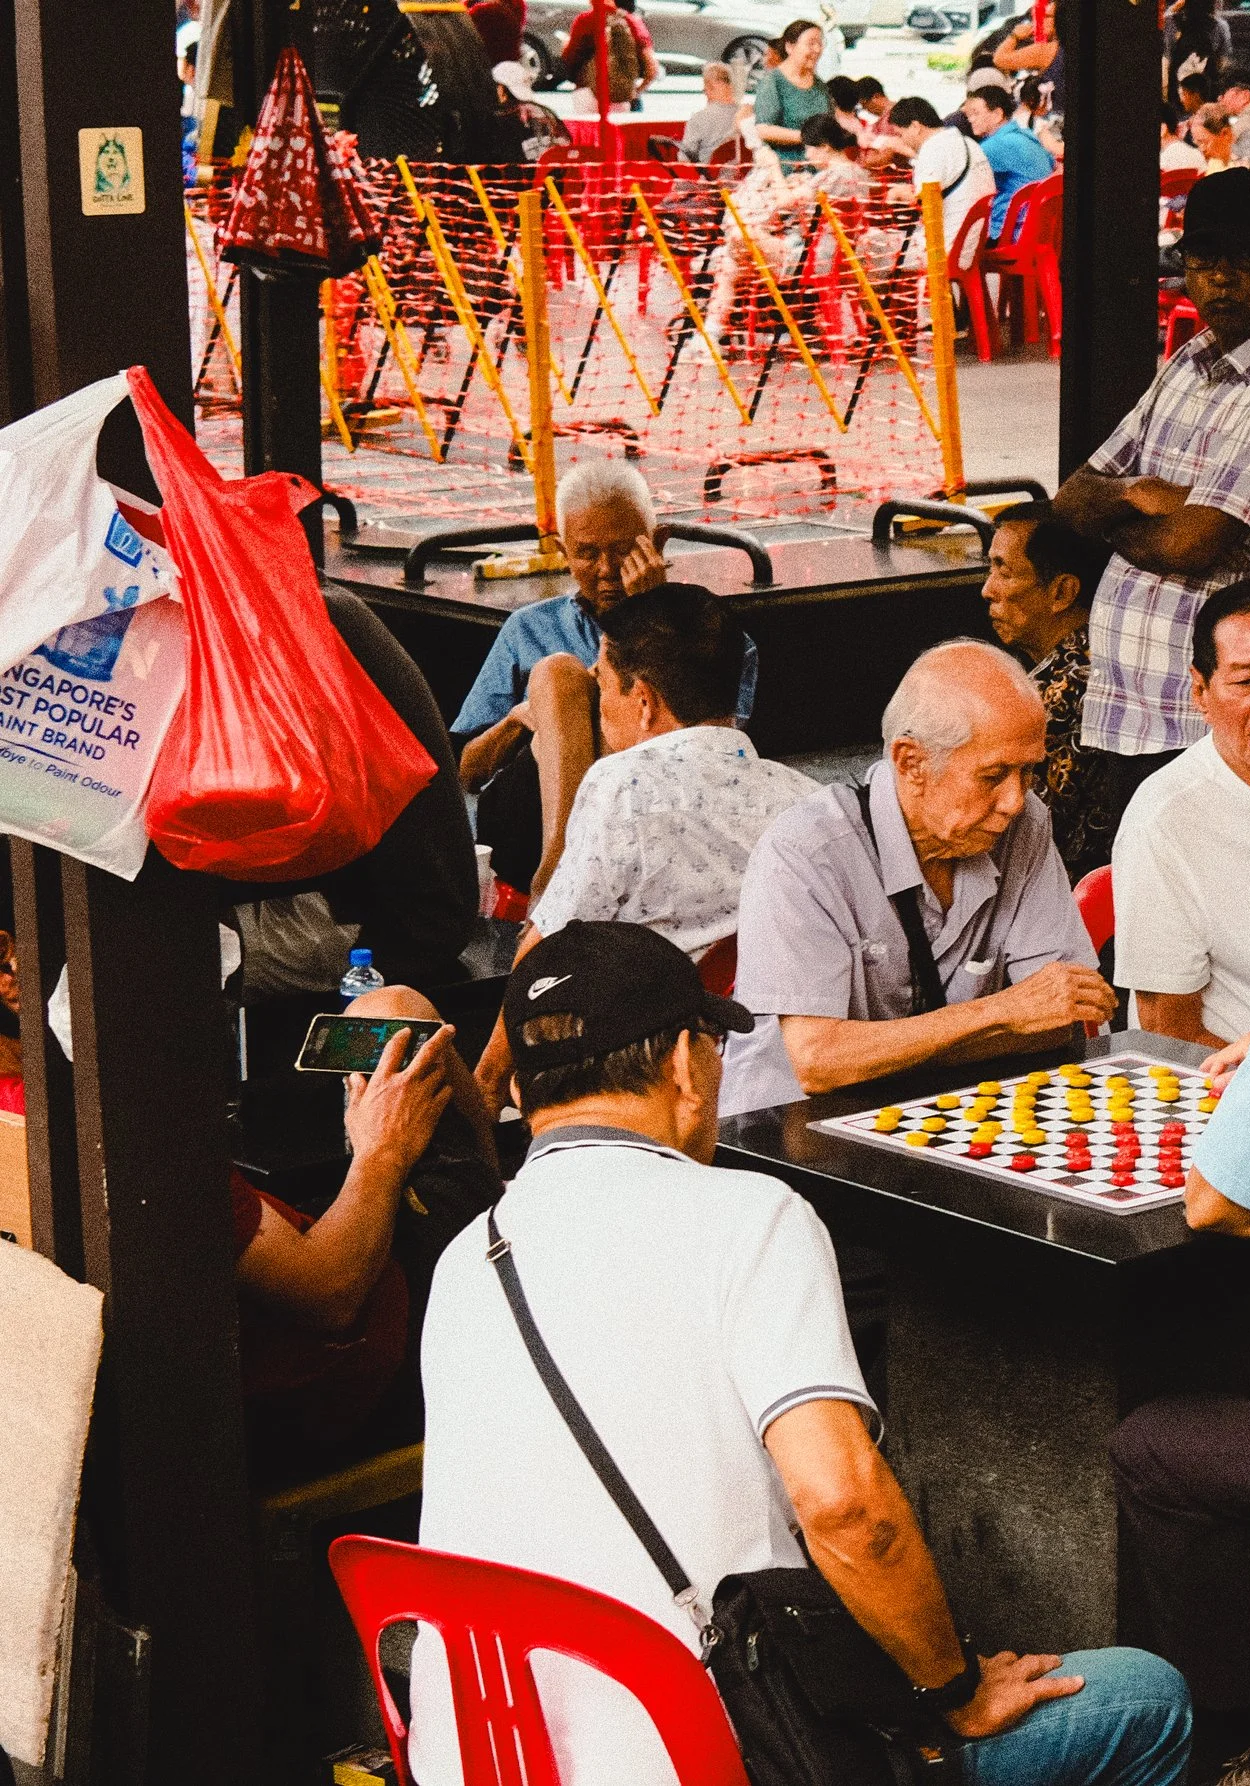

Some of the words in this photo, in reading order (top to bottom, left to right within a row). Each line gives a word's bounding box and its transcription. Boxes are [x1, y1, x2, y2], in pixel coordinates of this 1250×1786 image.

[0, 684, 31, 709] ST
[32, 696, 140, 750] POPULAR
[41, 727, 106, 761] BRAND
[44, 763, 79, 783] Paint
[80, 775, 122, 797] Odour
